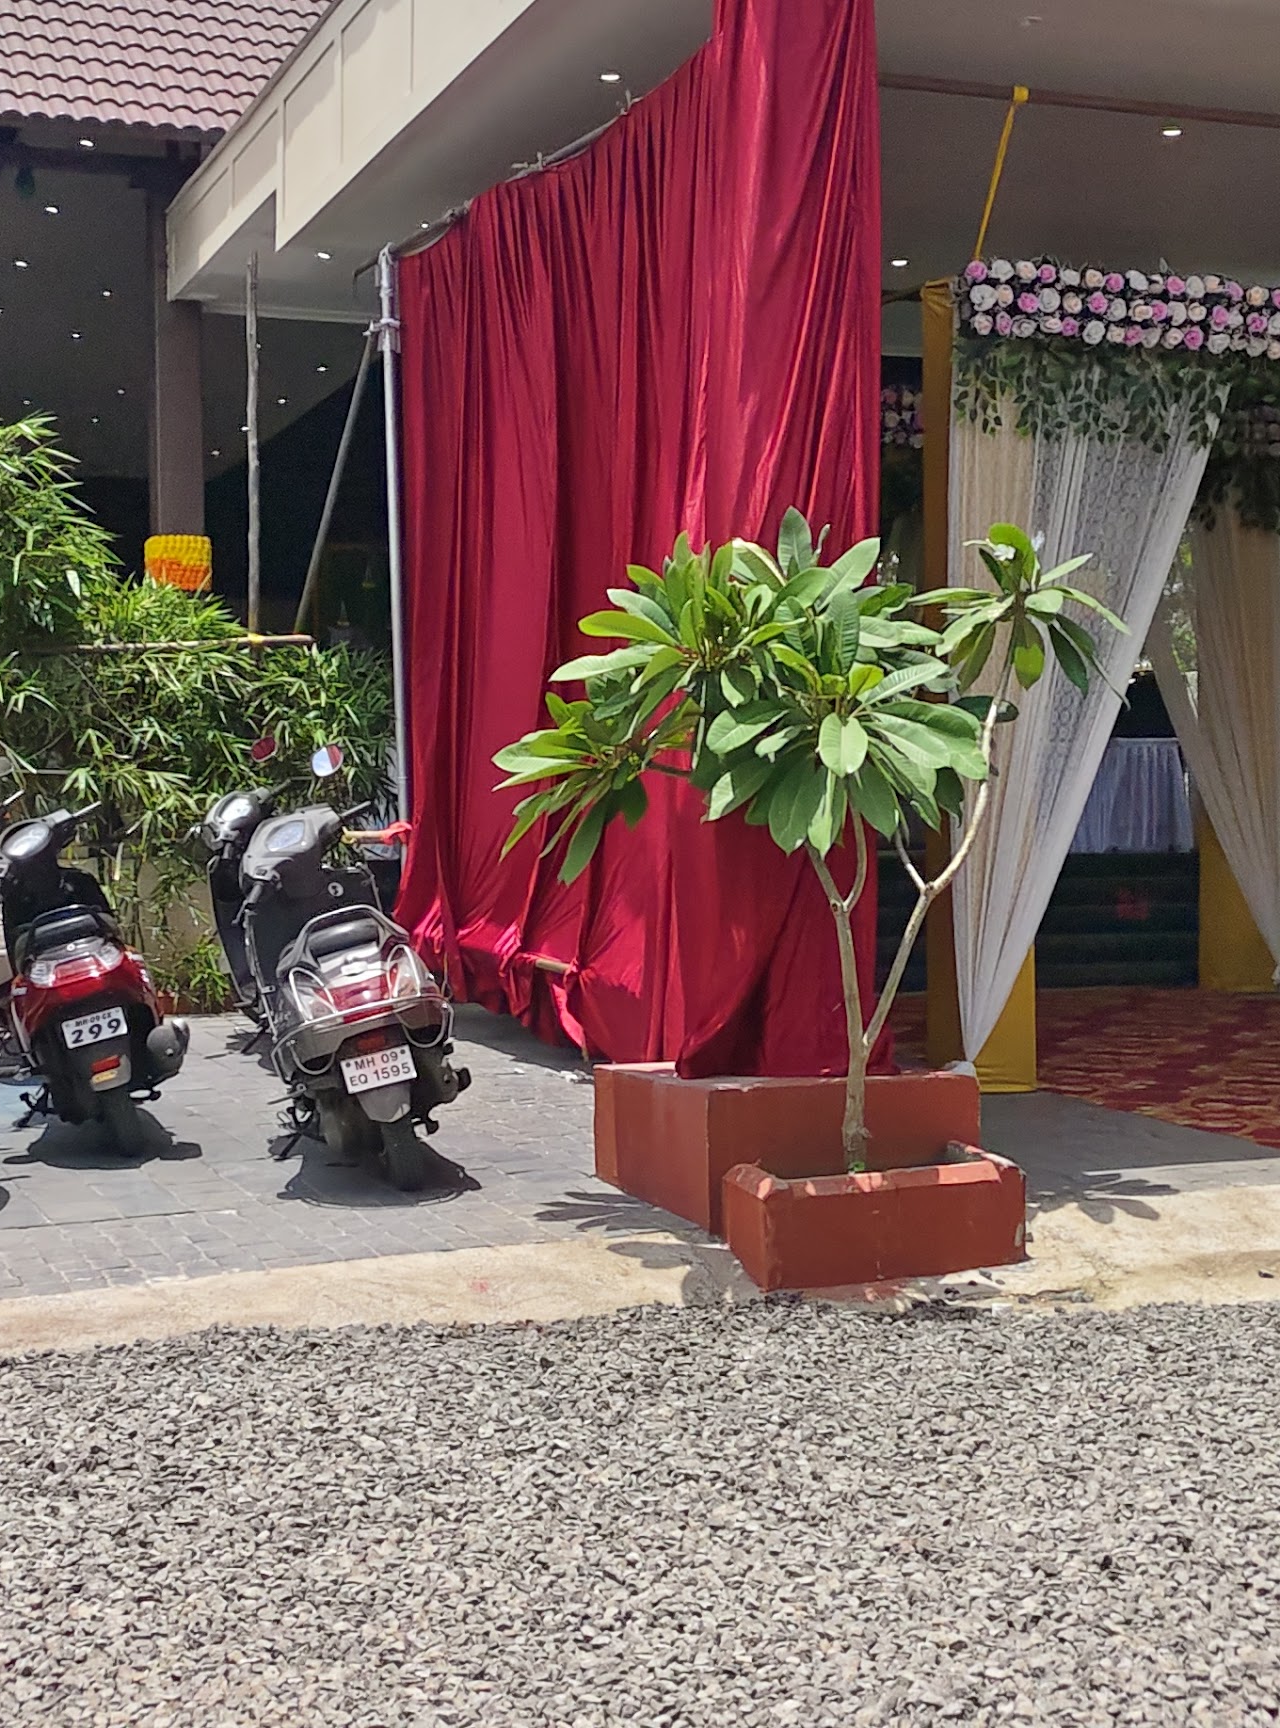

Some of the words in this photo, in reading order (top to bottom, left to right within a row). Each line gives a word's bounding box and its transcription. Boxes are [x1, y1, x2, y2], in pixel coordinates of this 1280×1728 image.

[70, 1018, 121, 1045] 299
[354, 1056, 376, 1070] MH
[380, 1051, 398, 1064] 09
[349, 1073, 369, 1087] EQ
[373, 1062, 411, 1081] 1595
